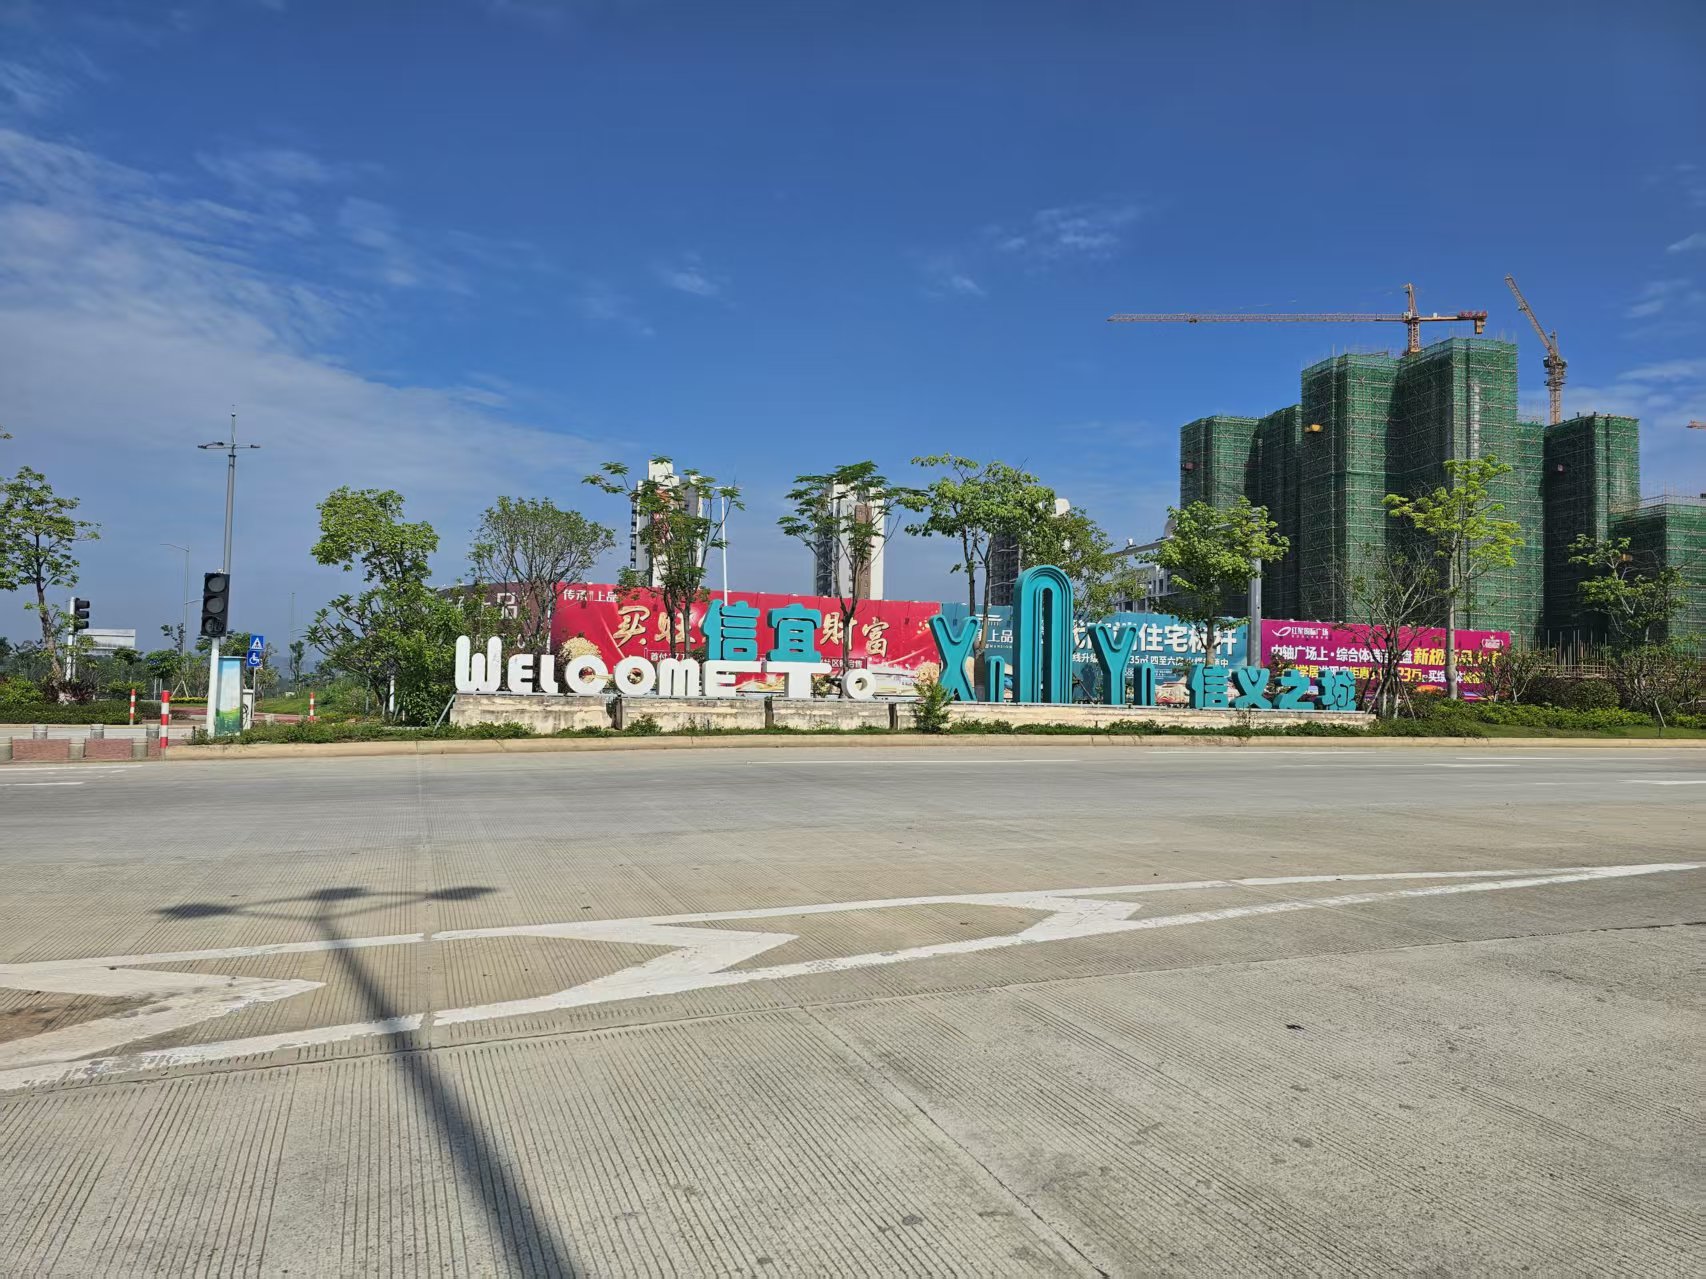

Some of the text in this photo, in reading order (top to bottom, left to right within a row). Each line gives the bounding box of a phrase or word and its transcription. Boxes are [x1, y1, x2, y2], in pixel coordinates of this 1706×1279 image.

[701, 599, 821, 662] 信宜
[455, 635, 761, 698] WELCOME
[1188, 663, 1357, 711] 信义之城
